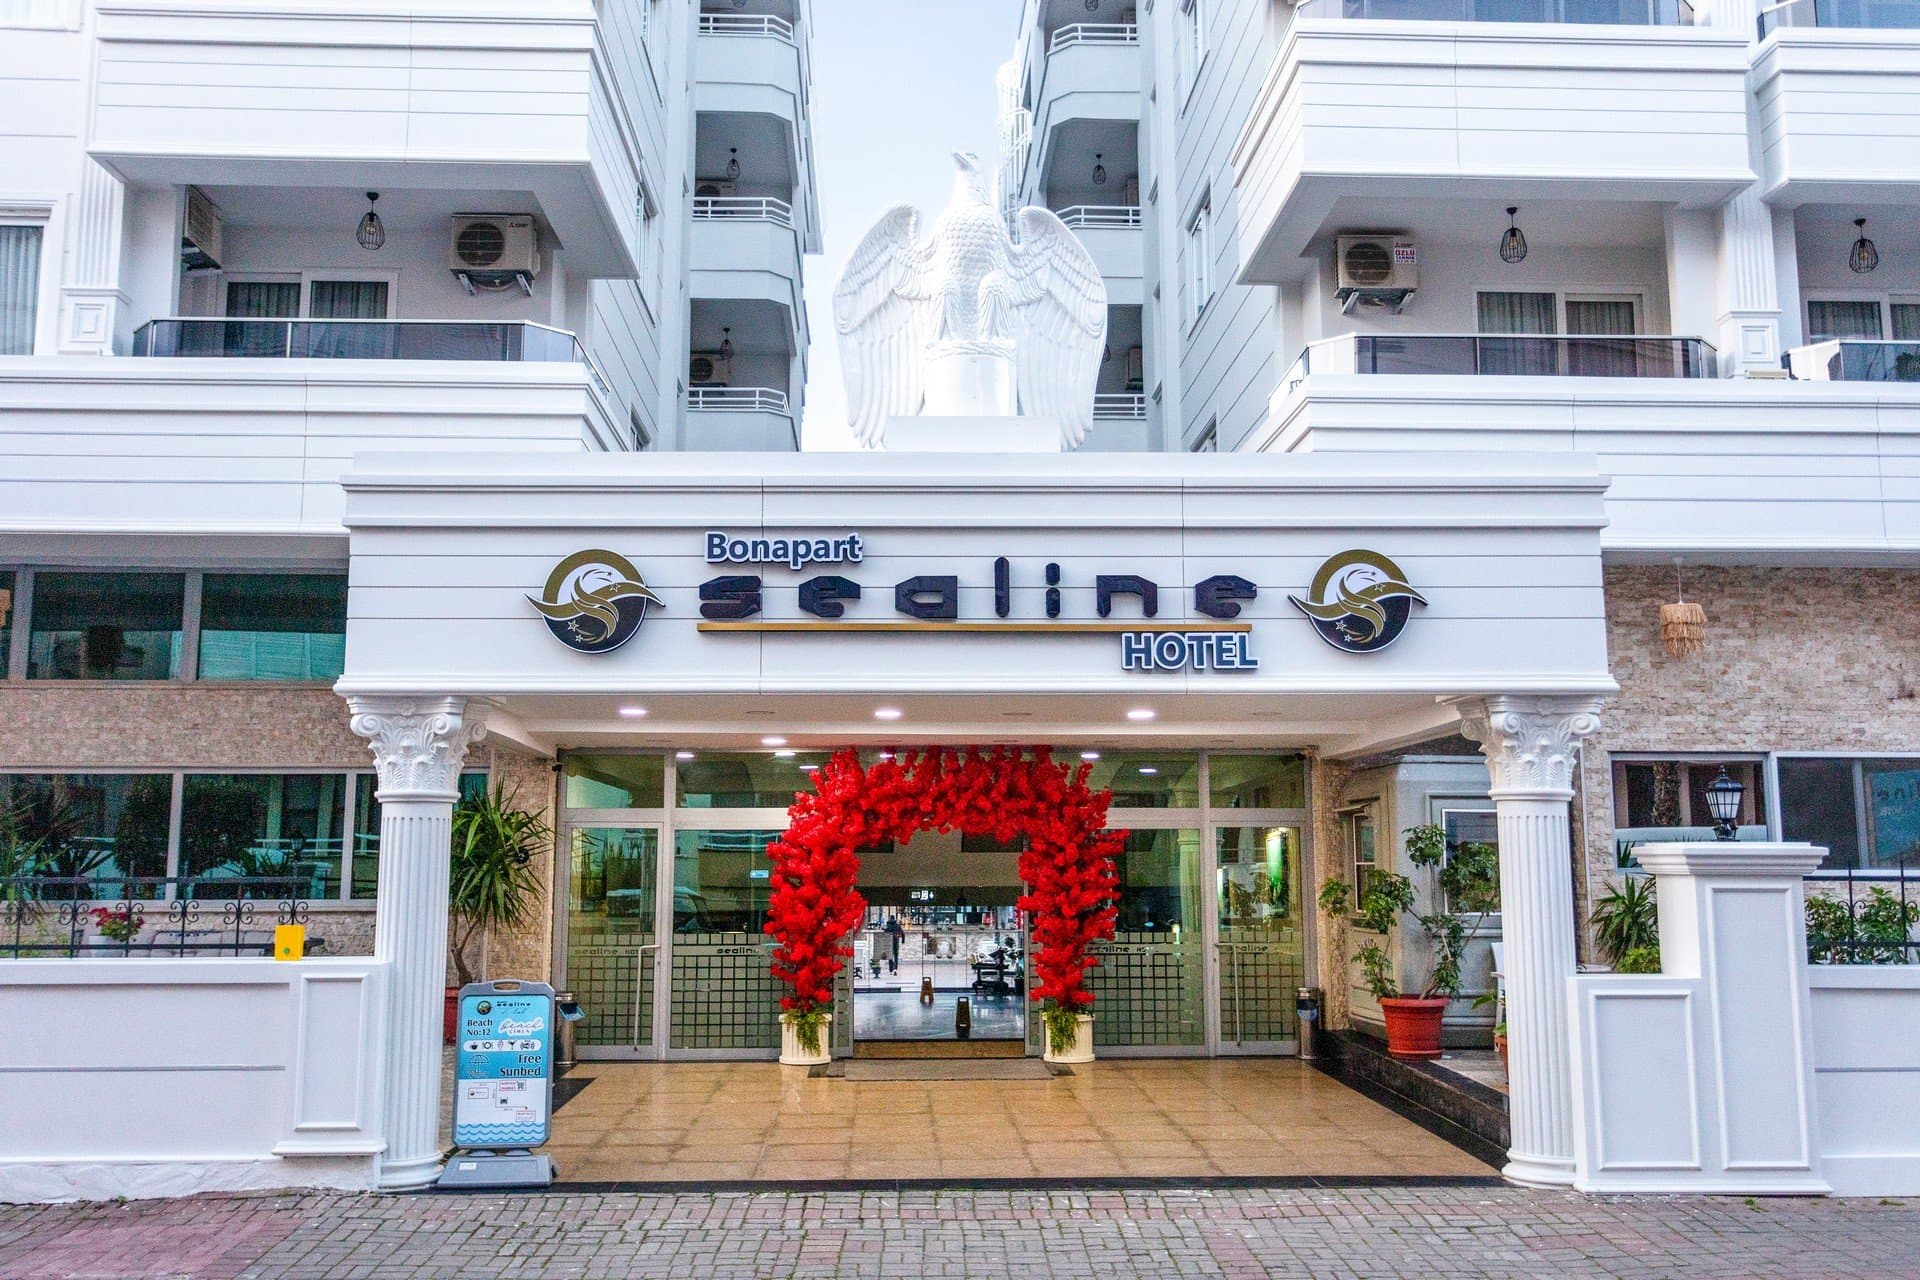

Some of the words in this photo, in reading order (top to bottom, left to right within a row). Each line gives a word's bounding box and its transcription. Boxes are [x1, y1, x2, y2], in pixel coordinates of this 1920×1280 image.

[705, 532, 863, 569] Bonapart
[699, 555, 1258, 620] sealine
[1121, 632, 1259, 671] HOTEL
[467, 1019, 493, 1027] Beach
[518, 1054, 542, 1064] Free
[500, 1067, 541, 1077] Sunbed
